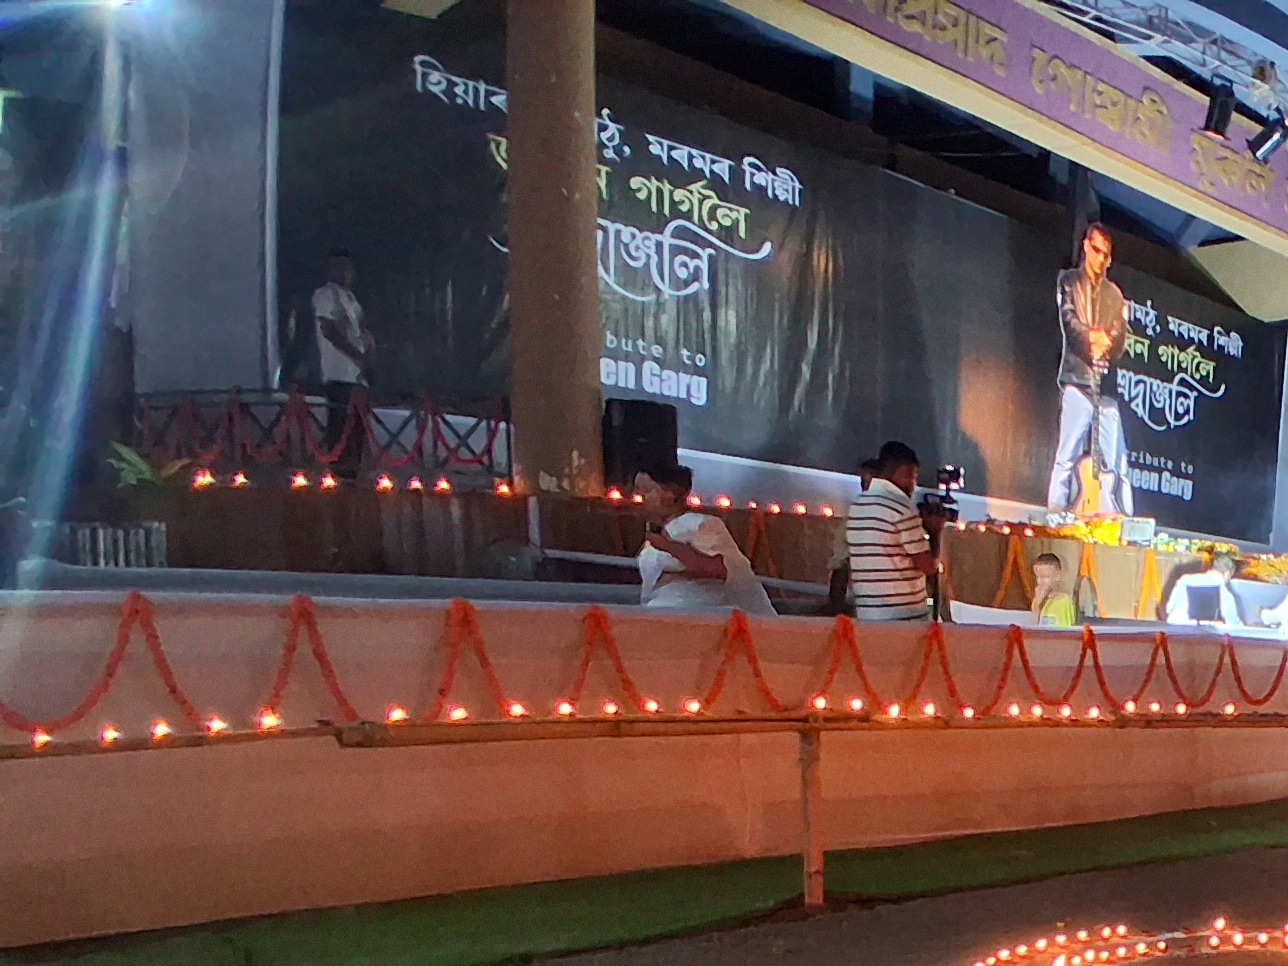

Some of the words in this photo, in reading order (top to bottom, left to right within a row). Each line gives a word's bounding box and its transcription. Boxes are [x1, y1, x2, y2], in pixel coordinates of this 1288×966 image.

[605, 330, 664, 359] bute
[680, 347, 706, 367] to
[641, 360, 708, 406] Garg
[1180, 461, 1194, 475] to
[1160, 470, 1194, 501] Garg
